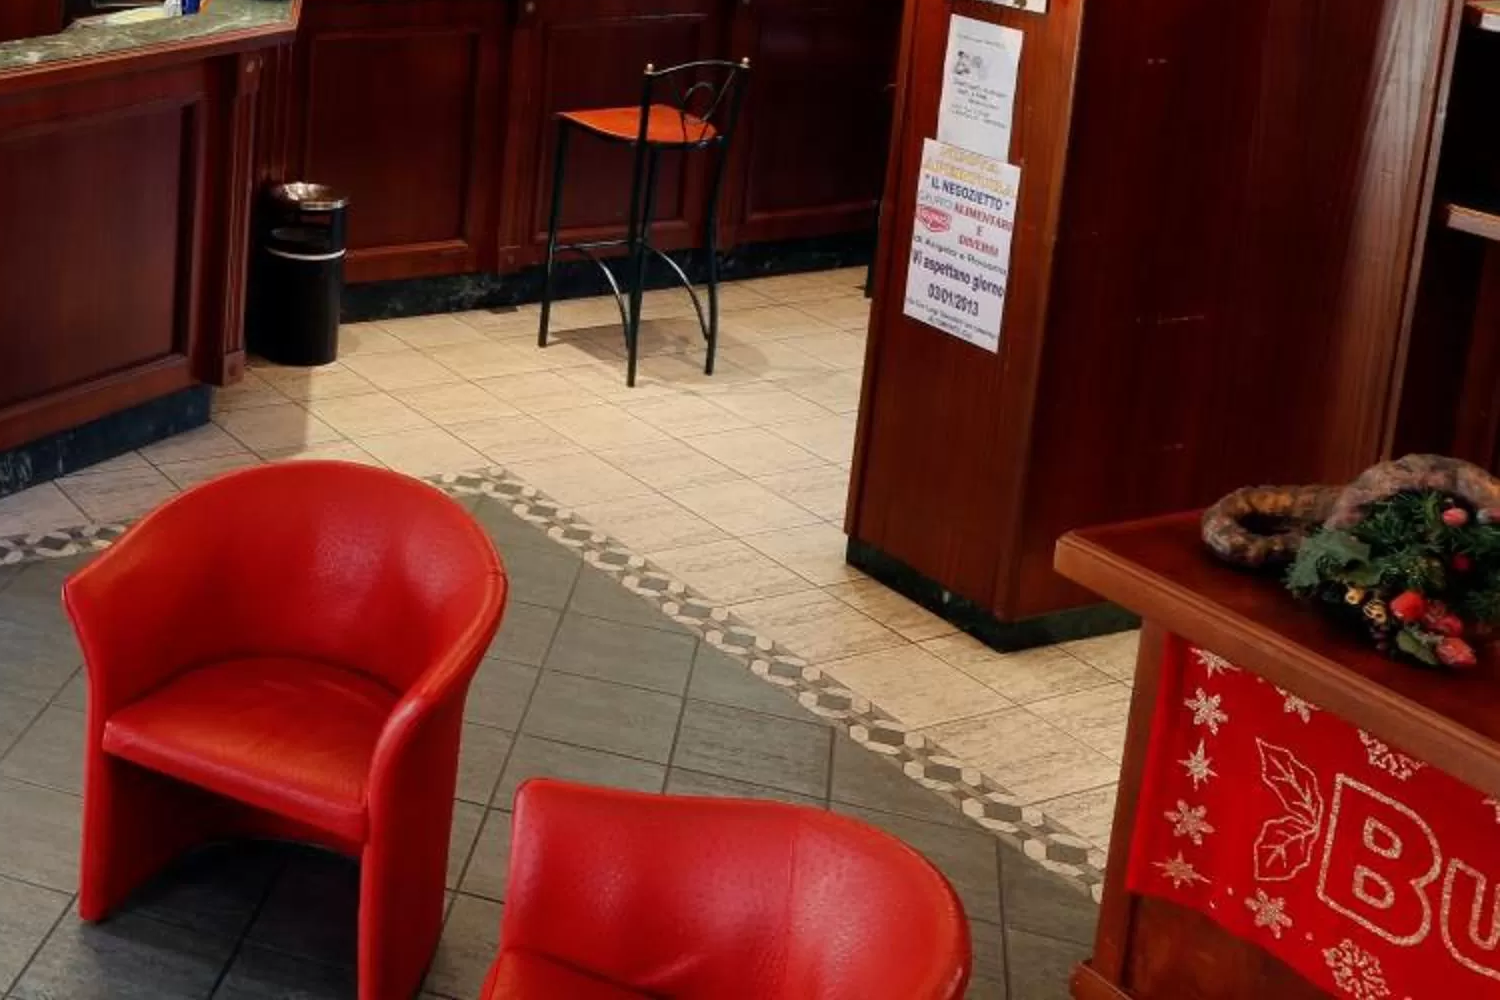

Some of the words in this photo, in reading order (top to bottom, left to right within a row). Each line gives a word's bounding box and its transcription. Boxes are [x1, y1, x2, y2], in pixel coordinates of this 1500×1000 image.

[942, 180, 1003, 211] NEGOZIETTO
[924, 256, 971, 285] aspettano
[971, 274, 1005, 298] giorno
